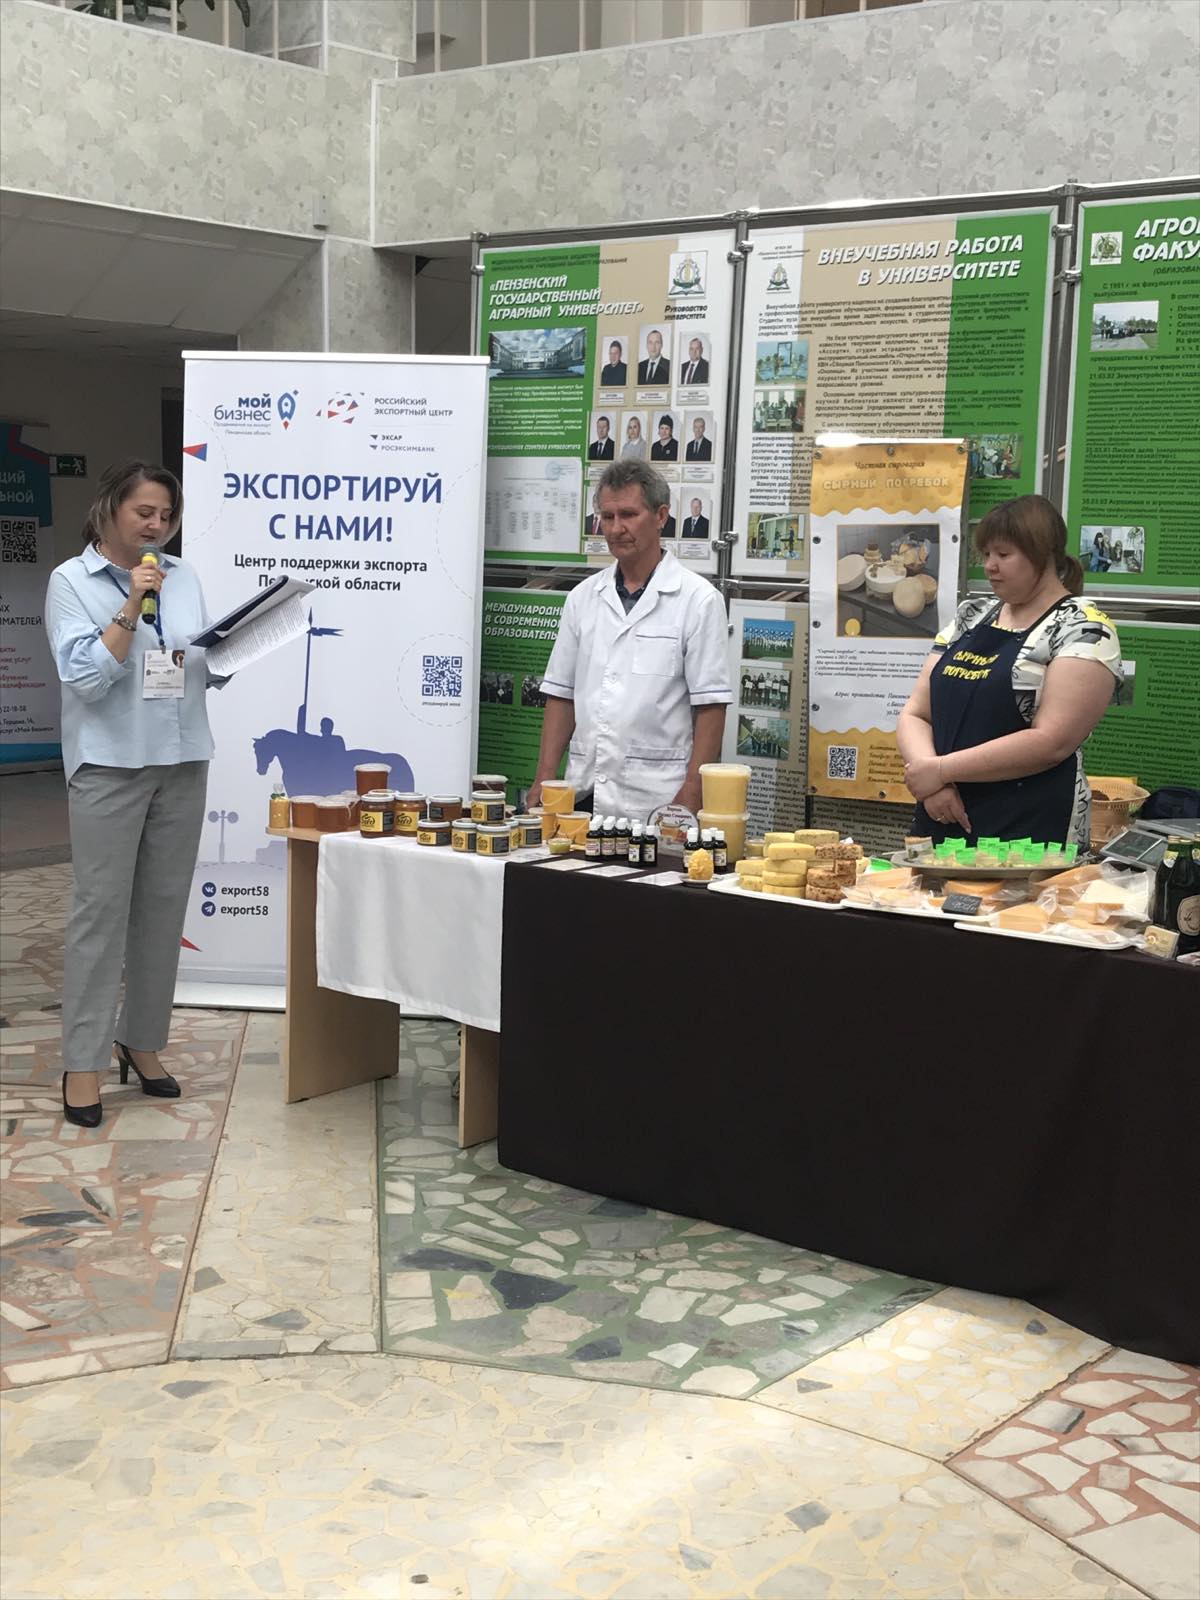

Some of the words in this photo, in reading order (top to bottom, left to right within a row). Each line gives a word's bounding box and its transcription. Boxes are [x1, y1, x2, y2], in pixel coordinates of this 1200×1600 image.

[1134, 216, 1200, 239] АГРО
[817, 240, 940, 266] ВНЕУЧЕБНАЯ
[945, 235, 1024, 257] РАБОТА
[1132, 240, 1200, 263] ФАКУ
[858, 269, 872, 286] В
[876, 259, 1022, 286] УНИВЕРСИТЕТЕ
[489, 274, 567, 291] «ПЕНЗЕНСКИЙ
[489, 287, 601, 306] ГОСУДАРСТВЕННЫЙ
[489, 305, 551, 321] АГРАРНЫЙ
[558, 301, 644, 318] УНИВЕРСИТЕТ»
[374, 397, 427, 405] РОССИЙСКИЙ
[214, 405, 272, 421] бизнес
[374, 408, 426, 416] ЭКСПОРТНЫЙ
[428, 409, 454, 417] ЦЕНТР
[223, 473, 442, 504] ЭКСПОРТИРУЙ
[268, 513, 286, 540] С
[295, 514, 393, 543] НАМИ!
[234, 553, 276, 571] Центр
[281, 555, 360, 573] поддержки
[364, 559, 427, 574] экспорта
[258, 574, 340, 592] Пеской
[345, 577, 400, 592] области
[485, 614, 492, 624] В
[494, 615, 561, 628] СОВРЕМЕННО
[221, 885, 270, 899] export58
[220, 904, 269, 917] export58
